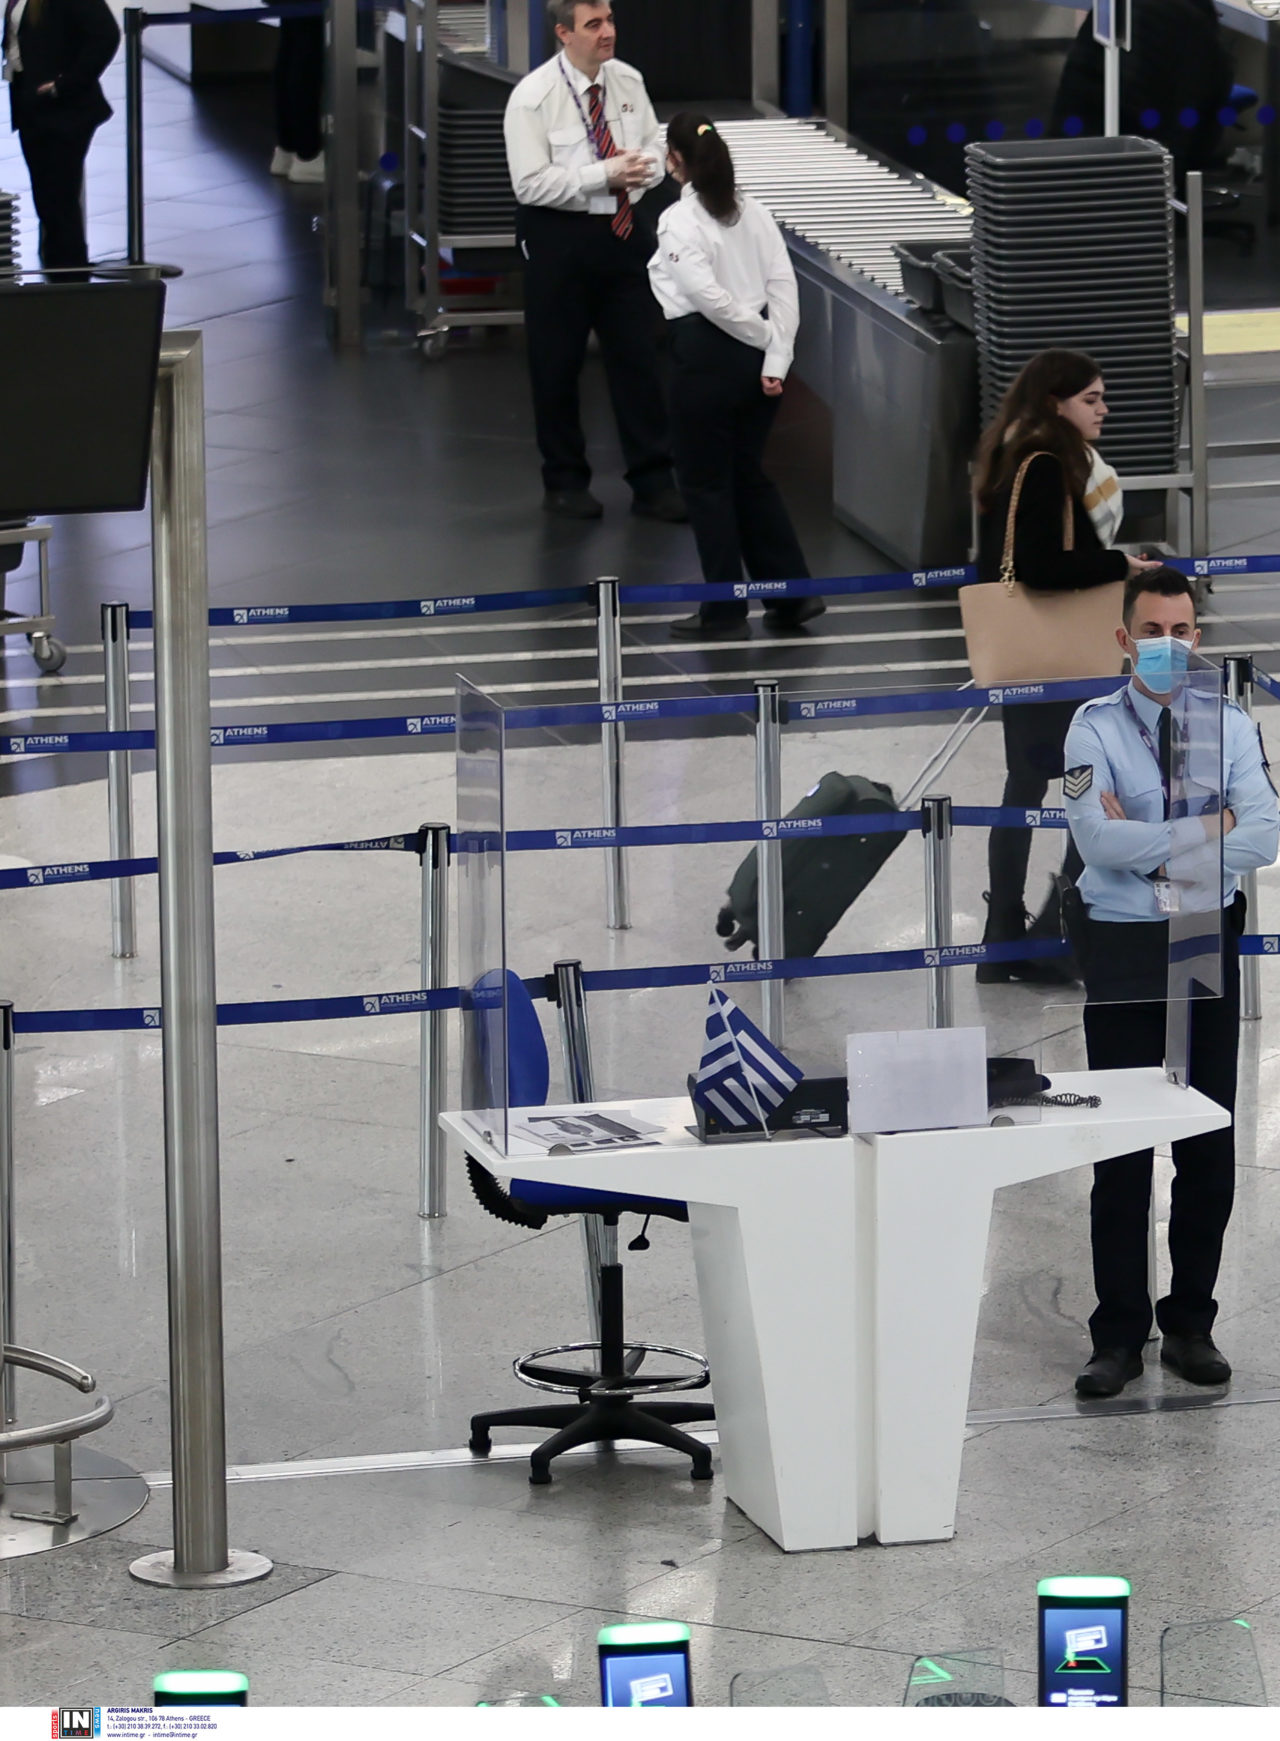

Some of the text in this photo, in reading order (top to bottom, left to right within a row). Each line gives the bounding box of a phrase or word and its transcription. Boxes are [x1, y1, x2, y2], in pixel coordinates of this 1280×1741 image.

[1208, 558, 1248, 568] ATHENS
[927, 568, 965, 579] ATHENS
[748, 581, 787, 591] ATHENS
[435, 597, 475, 607] ATHENS
[248, 607, 289, 616] ATHENS
[1003, 685, 1044, 696] ATHENS
[617, 702, 659, 712] ATHENS
[816, 700, 857, 710] ATHENS
[422, 715, 456, 725] ATHEN
[225, 726, 268, 736] ATHENS
[26, 735, 69, 745] ATHENS
[778, 819, 822, 830] ATHENS
[573, 829, 616, 839] ATHENS
[44, 864, 90, 876] ATHENS
[940, 944, 987, 956] ATHENS
[726, 961, 773, 972] ATHENS
[380, 992, 427, 1004] ATHENS
